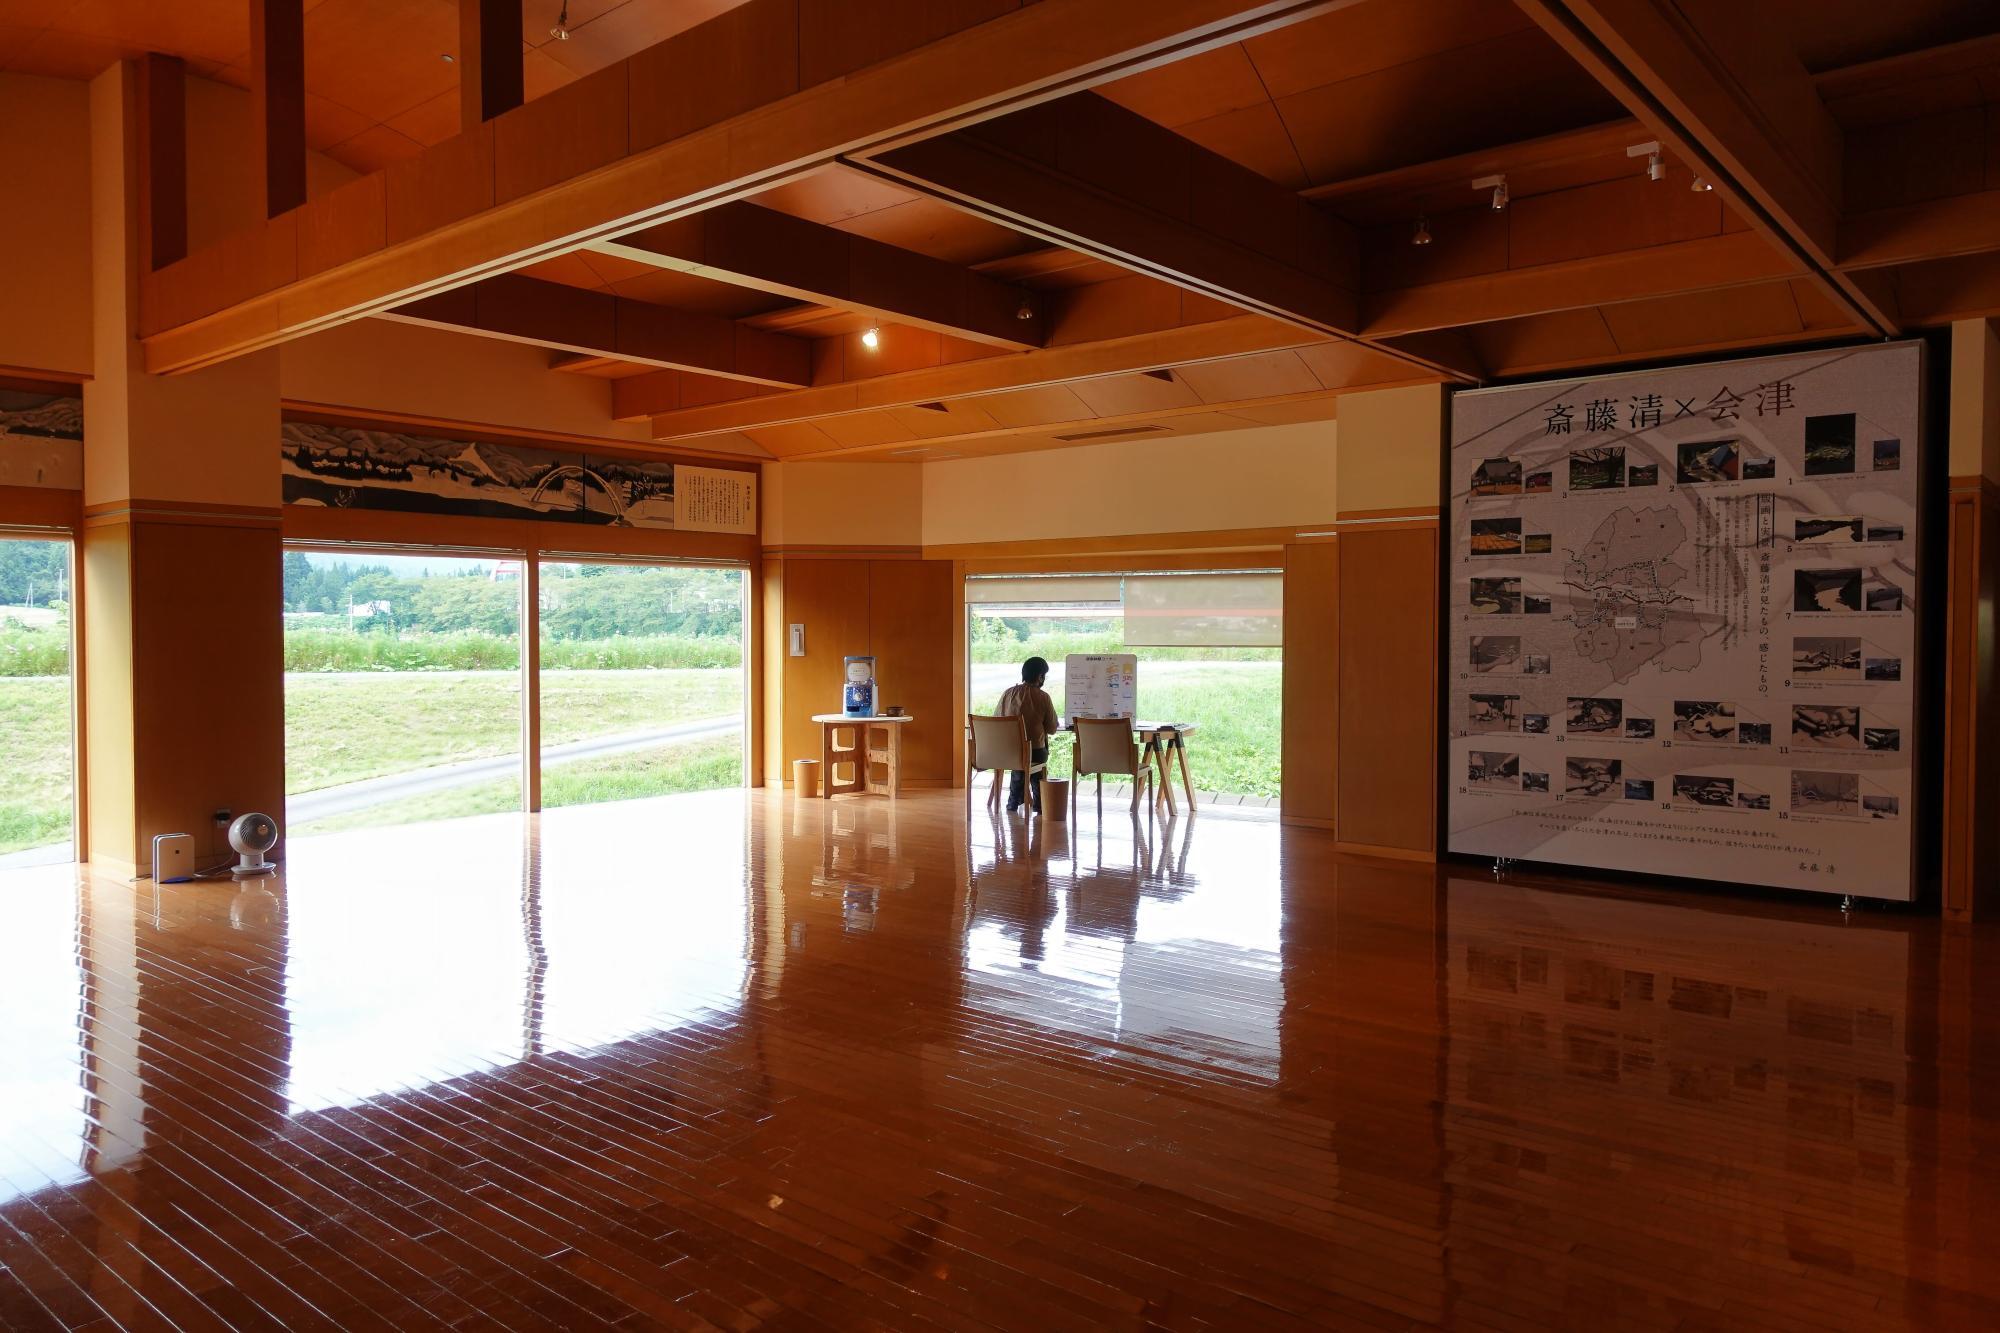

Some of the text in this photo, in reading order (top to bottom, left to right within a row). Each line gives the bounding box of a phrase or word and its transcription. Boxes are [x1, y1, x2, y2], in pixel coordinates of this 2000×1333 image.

[1544, 381, 1796, 436] 斎藤清×会津
[1788, 477, 1793, 486] 1
[1669, 485, 1675, 493] 2
[1786, 545, 1793, 553] 5
[1785, 612, 1791, 620] 7
[1460, 672, 1469, 680] 10
[1784, 679, 1791, 688] 9
[1662, 740, 1672, 748] 12
[1779, 746, 1789, 754] 11
[1459, 786, 1468, 794] 18
[1556, 793, 1564, 801] 17
[1661, 802, 1671, 810] 16
[1778, 811, 1789, 819] 15
